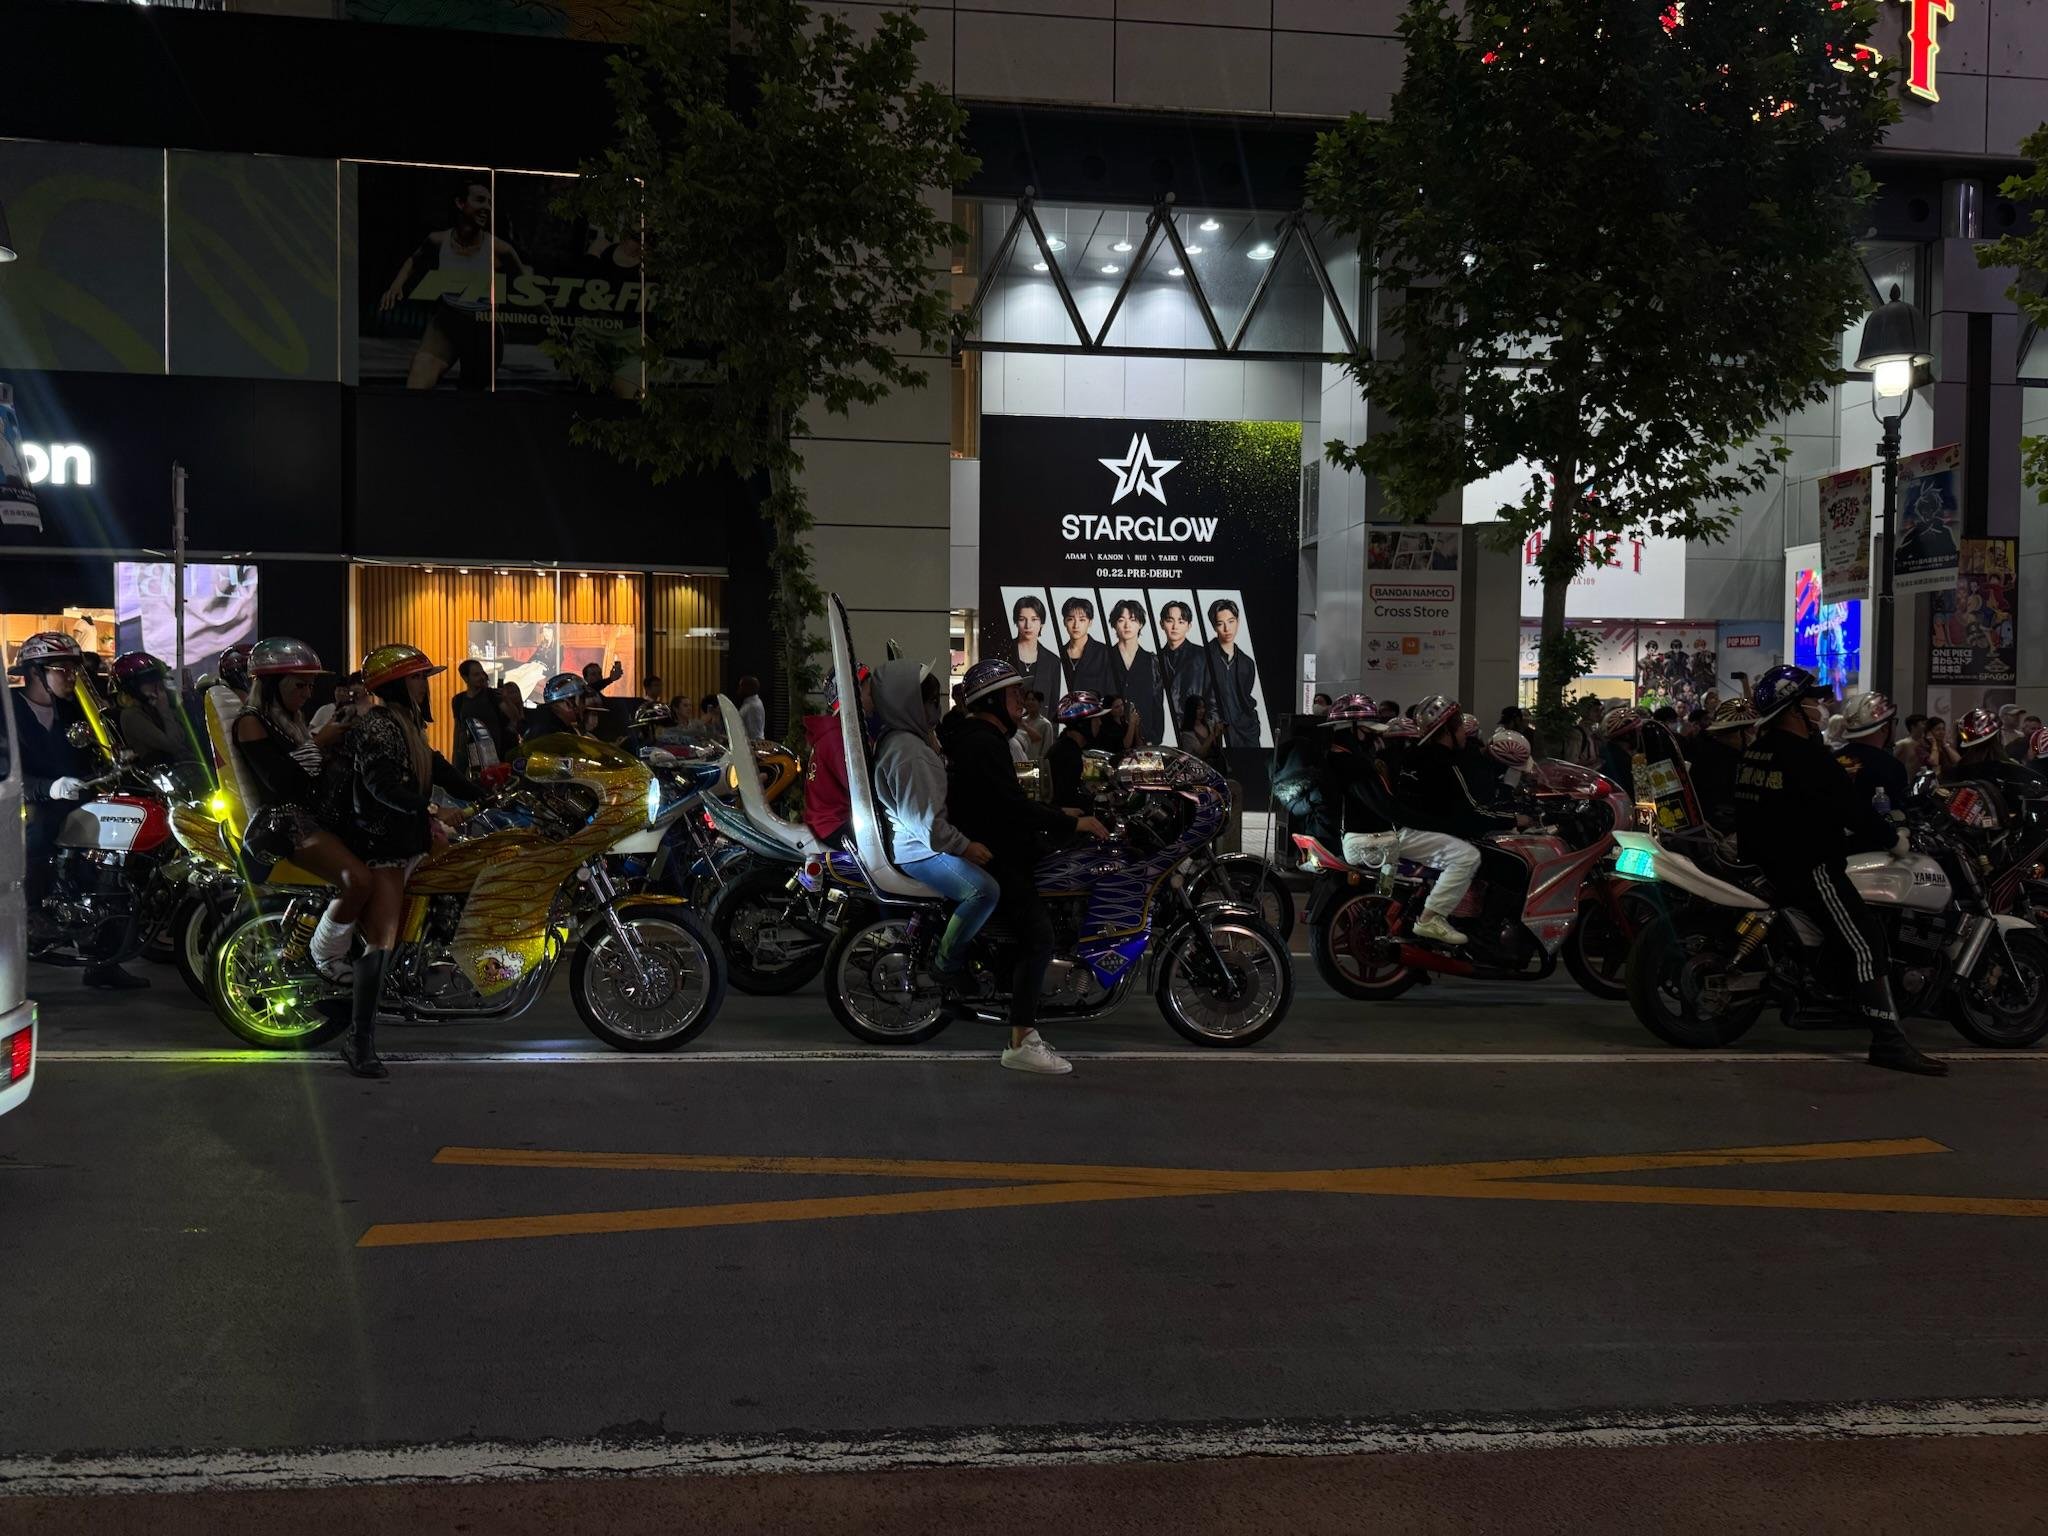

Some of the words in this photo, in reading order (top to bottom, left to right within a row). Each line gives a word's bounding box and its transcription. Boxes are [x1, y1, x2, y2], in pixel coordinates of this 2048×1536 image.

[475, 311, 538, 326] RUNNING
[539, 312, 624, 331] COLLECTION
[1061, 514, 1219, 543] STARGLOW
[1065, 553, 1087, 561] ADAM
[1097, 554, 1124, 562] KANON
[1188, 555, 1215, 563] GOICHI
[1375, 588, 1411, 598] BANDAI
[1413, 589, 1450, 598] NAMCO
[1374, 605, 1411, 618] Cross
[1413, 605, 1450, 618] Store
[1932, 648, 1951, 657] ONE
[1952, 648, 1973, 657] PIECE
[1912, 871, 1947, 882] YAMAHA
